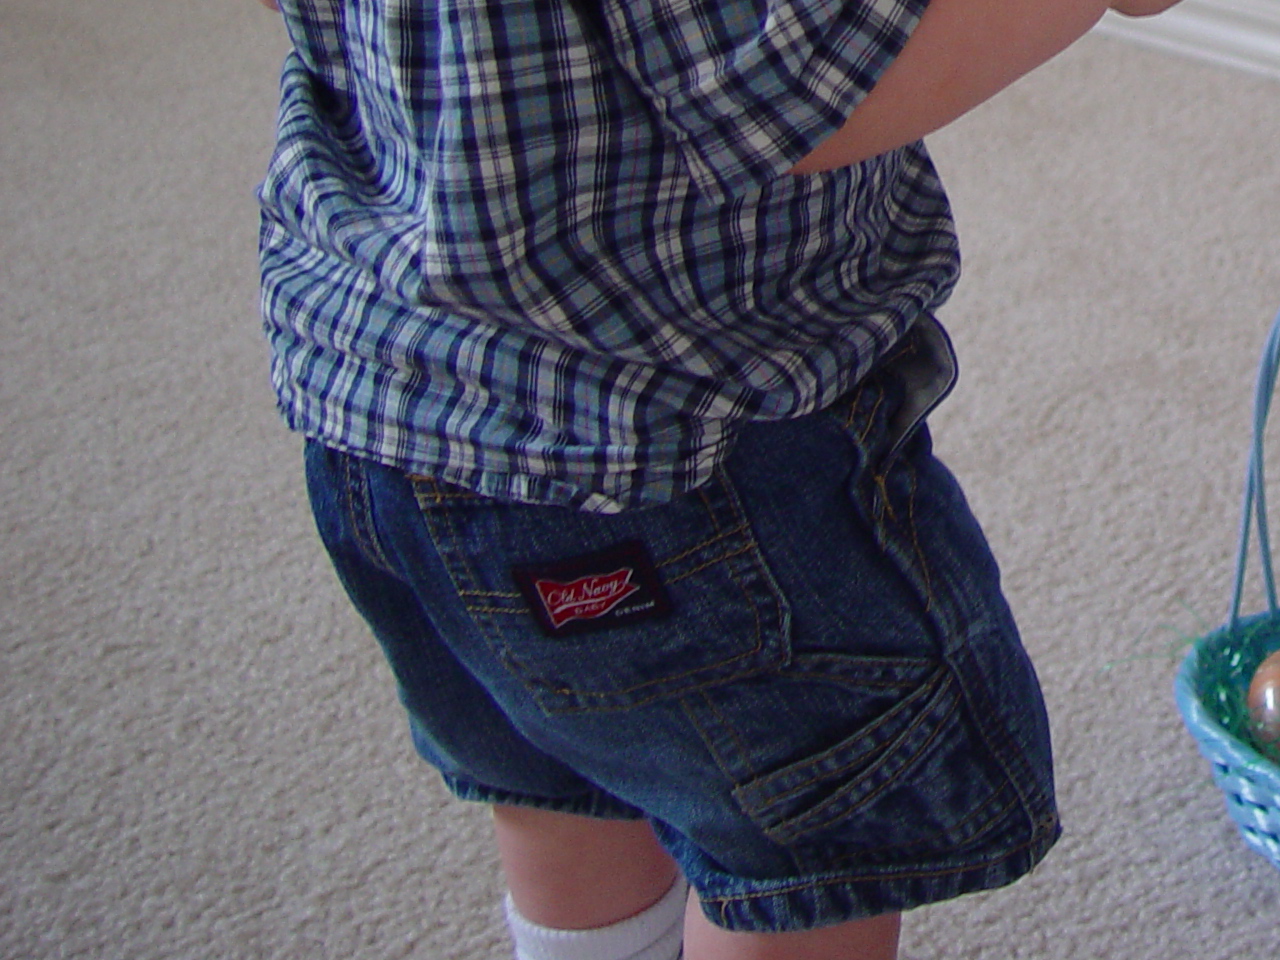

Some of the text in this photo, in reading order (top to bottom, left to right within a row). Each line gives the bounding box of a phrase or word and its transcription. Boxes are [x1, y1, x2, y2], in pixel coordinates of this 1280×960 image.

[547, 578, 620, 606] Old Navy
[574, 601, 606, 615] BABY
